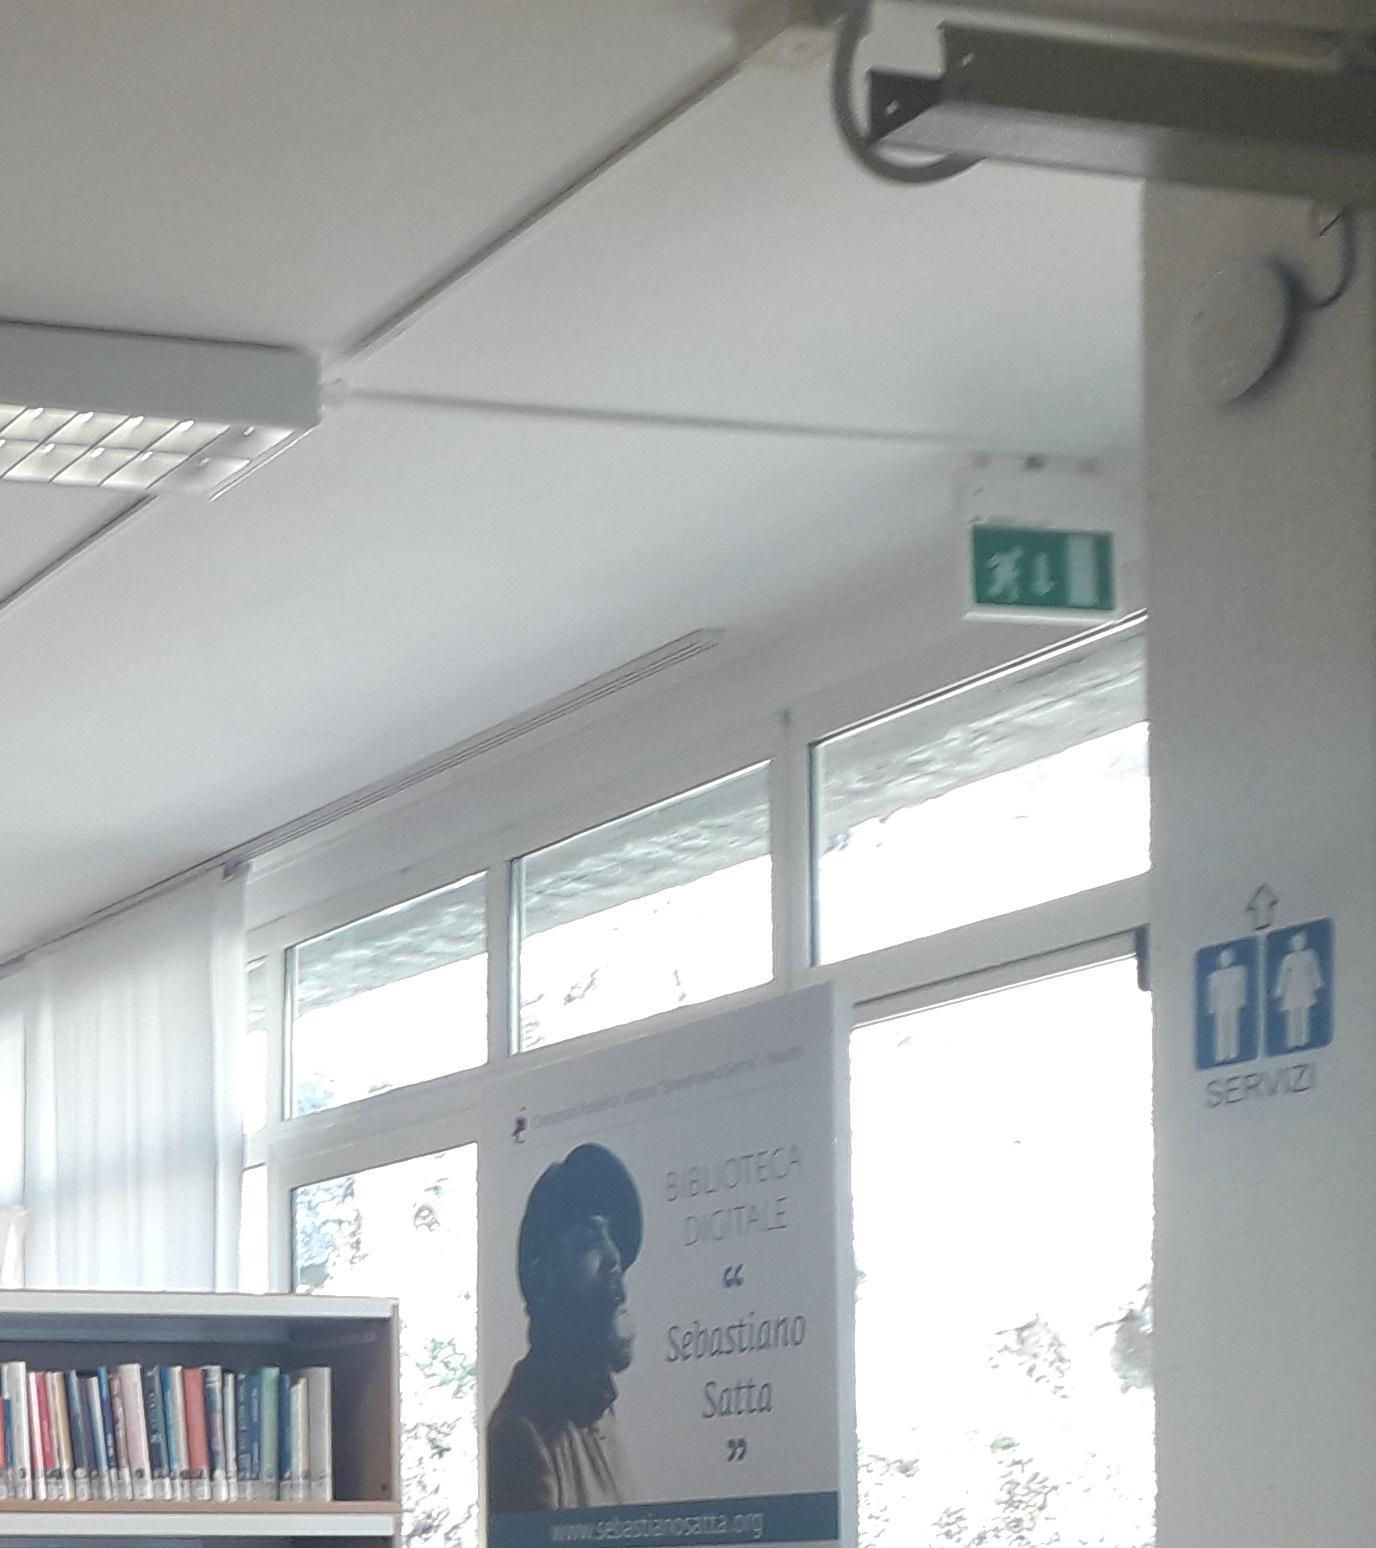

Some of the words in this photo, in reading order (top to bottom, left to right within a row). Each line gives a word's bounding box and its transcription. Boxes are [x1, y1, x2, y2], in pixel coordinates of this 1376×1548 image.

[1205, 1060, 1317, 1111] SERVIZI
[664, 1144, 804, 1203] BIBLIOTECA
[685, 1197, 788, 1247] DIGITALE
[665, 1310, 807, 1363] Sebastiano
[702, 1380, 774, 1419] Satta
[551, 1511, 765, 1543] www.sebastianosatta.org
